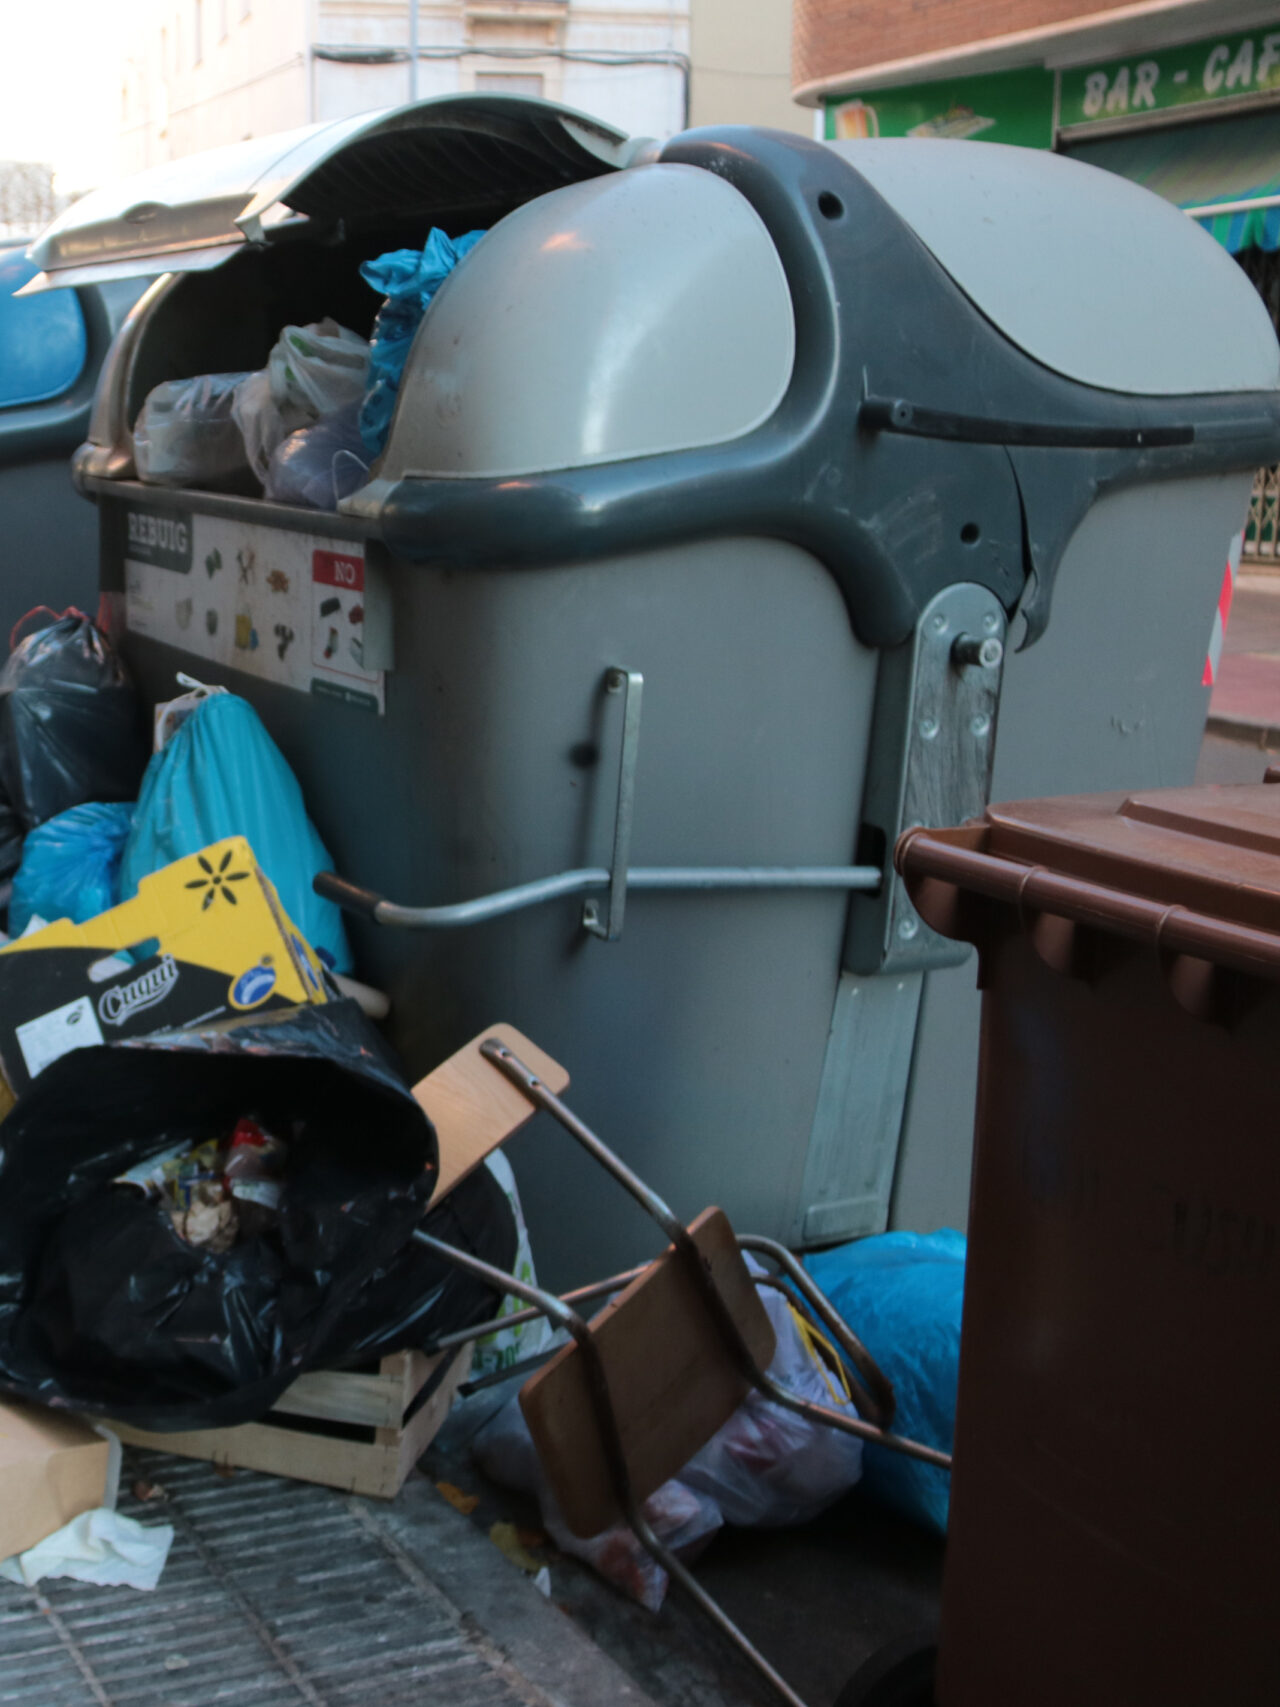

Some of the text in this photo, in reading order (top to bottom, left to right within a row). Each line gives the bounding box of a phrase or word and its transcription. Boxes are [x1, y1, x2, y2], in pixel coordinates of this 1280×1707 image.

[1084, 61, 1159, 118] BAR
[128, 511, 188, 554] REBUIG
[334, 559, 356, 584] NO
